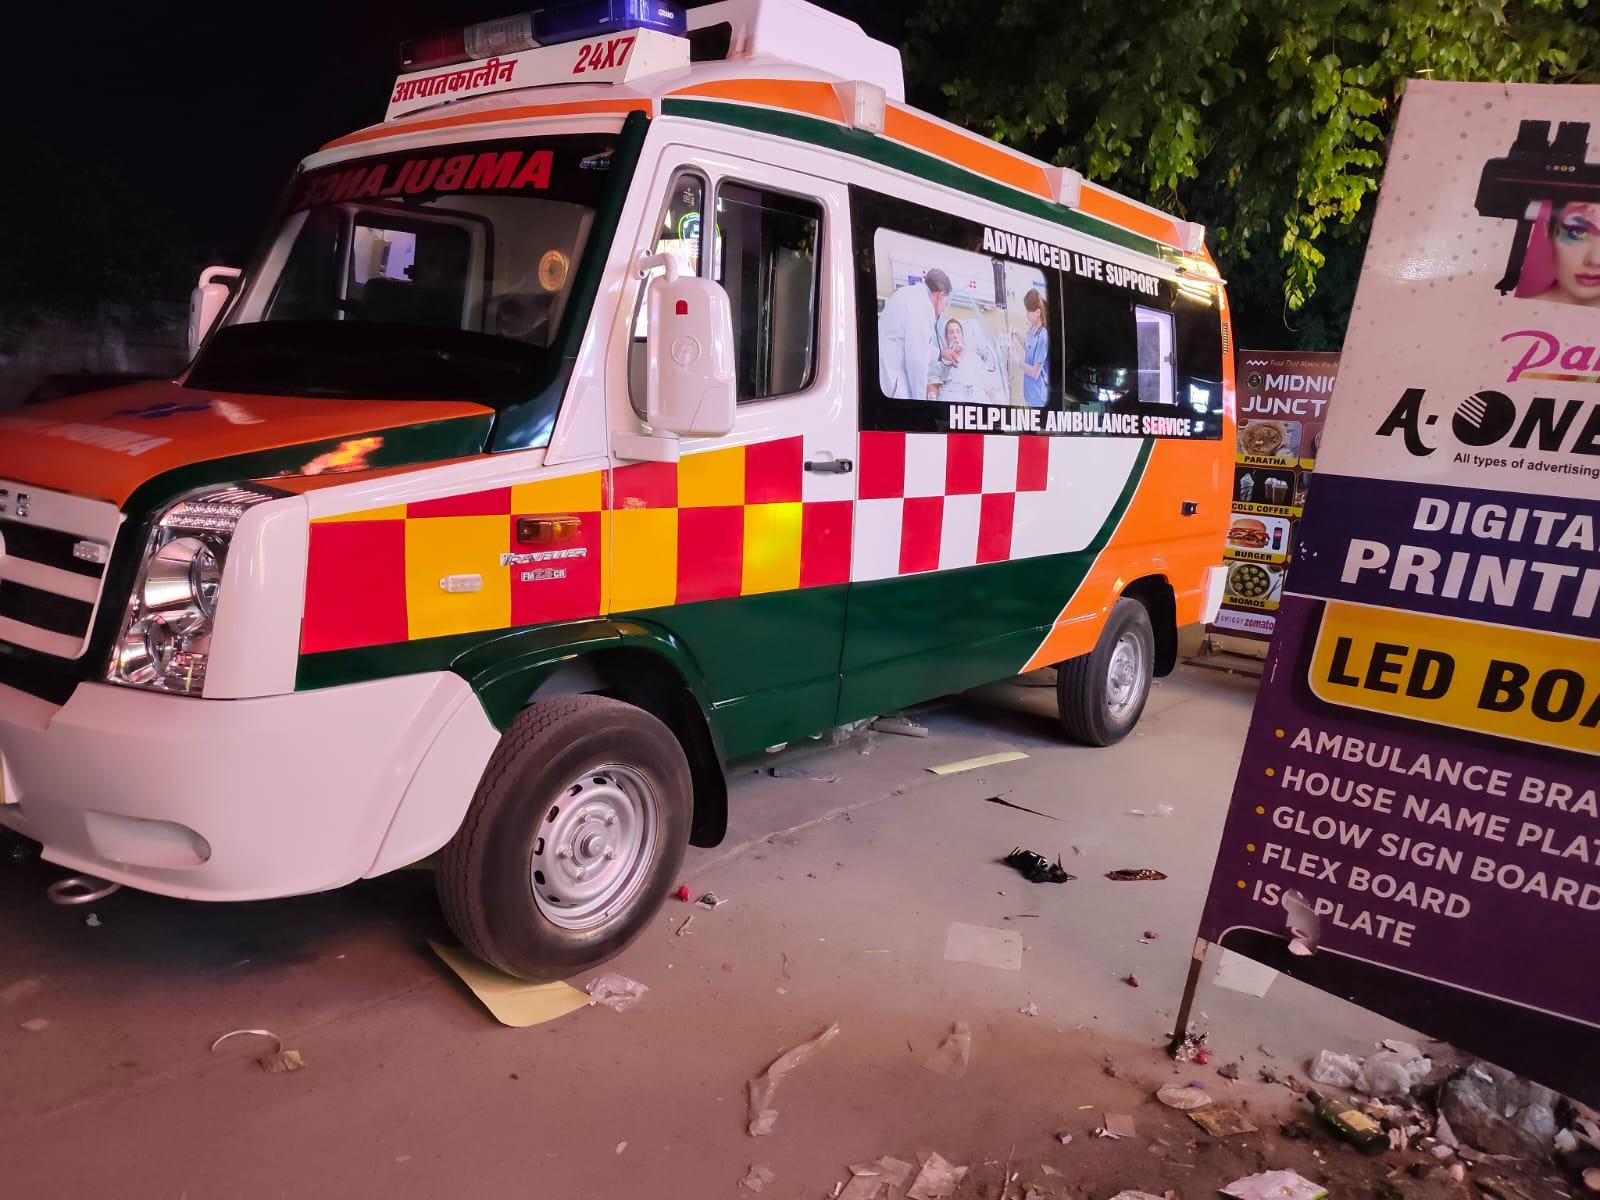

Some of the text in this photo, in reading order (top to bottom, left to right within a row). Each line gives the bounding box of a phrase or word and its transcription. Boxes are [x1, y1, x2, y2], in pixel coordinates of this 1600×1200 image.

[572, 36, 636, 74] 24X7
[392, 57, 518, 103] आपातकालीन
[983, 226, 1160, 297] ADVANCED LIFE SUPPORT
[1501, 330, 1600, 383] Pa
[949, 404, 1041, 432] HELPLINE
[1045, 409, 1139, 435] AMBULANCE
[1142, 415, 1191, 437] SERVICE
[1241, 395, 1328, 417] JUNCT
[1244, 455, 1286, 466] PARATHA
[1454, 451, 1600, 480] All types of advertising
[1232, 502, 1290, 515] COLD COFFEE
[1413, 497, 1600, 552] DIGITA
[1234, 550, 1273, 561] BURGER
[1229, 596, 1266, 608] MOMOS
[1244, 618, 1274, 630] zomato
[1327, 636, 1456, 700] LED
[1290, 727, 1599, 818] AMBULANCE BRA
[1281, 766, 1396, 814] HOUSE
[1402, 795, 1510, 842] NAME
[1272, 806, 1373, 849] GLOW
[1377, 833, 1464, 874] SIGN
[1261, 843, 1471, 919] FLEX BOARD
[1314, 897, 1416, 947] PLATE
